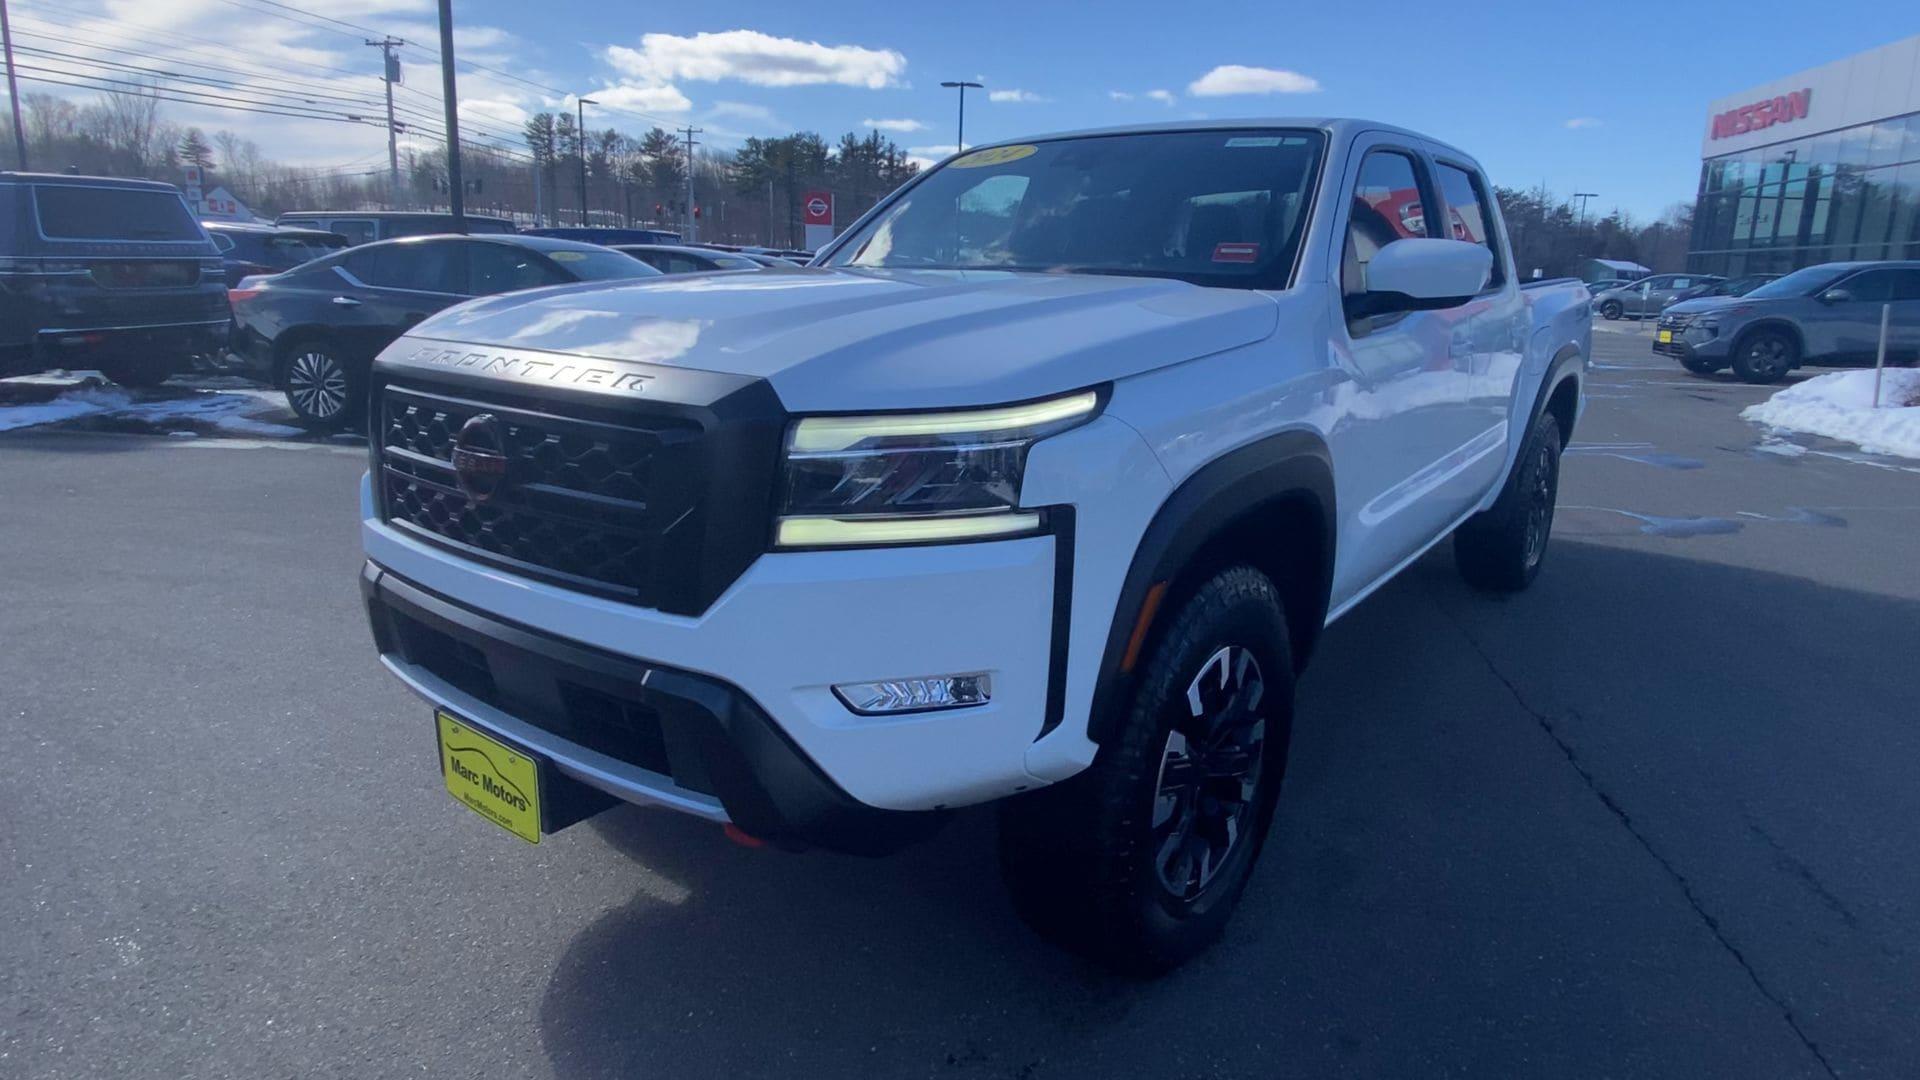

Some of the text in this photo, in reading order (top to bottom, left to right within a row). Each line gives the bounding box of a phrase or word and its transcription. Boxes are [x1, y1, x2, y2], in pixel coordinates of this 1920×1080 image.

[1711, 88, 1811, 140] NISSAN
[408, 348, 656, 392] FRONTIER
[450, 756, 526, 812] Marc Motors
